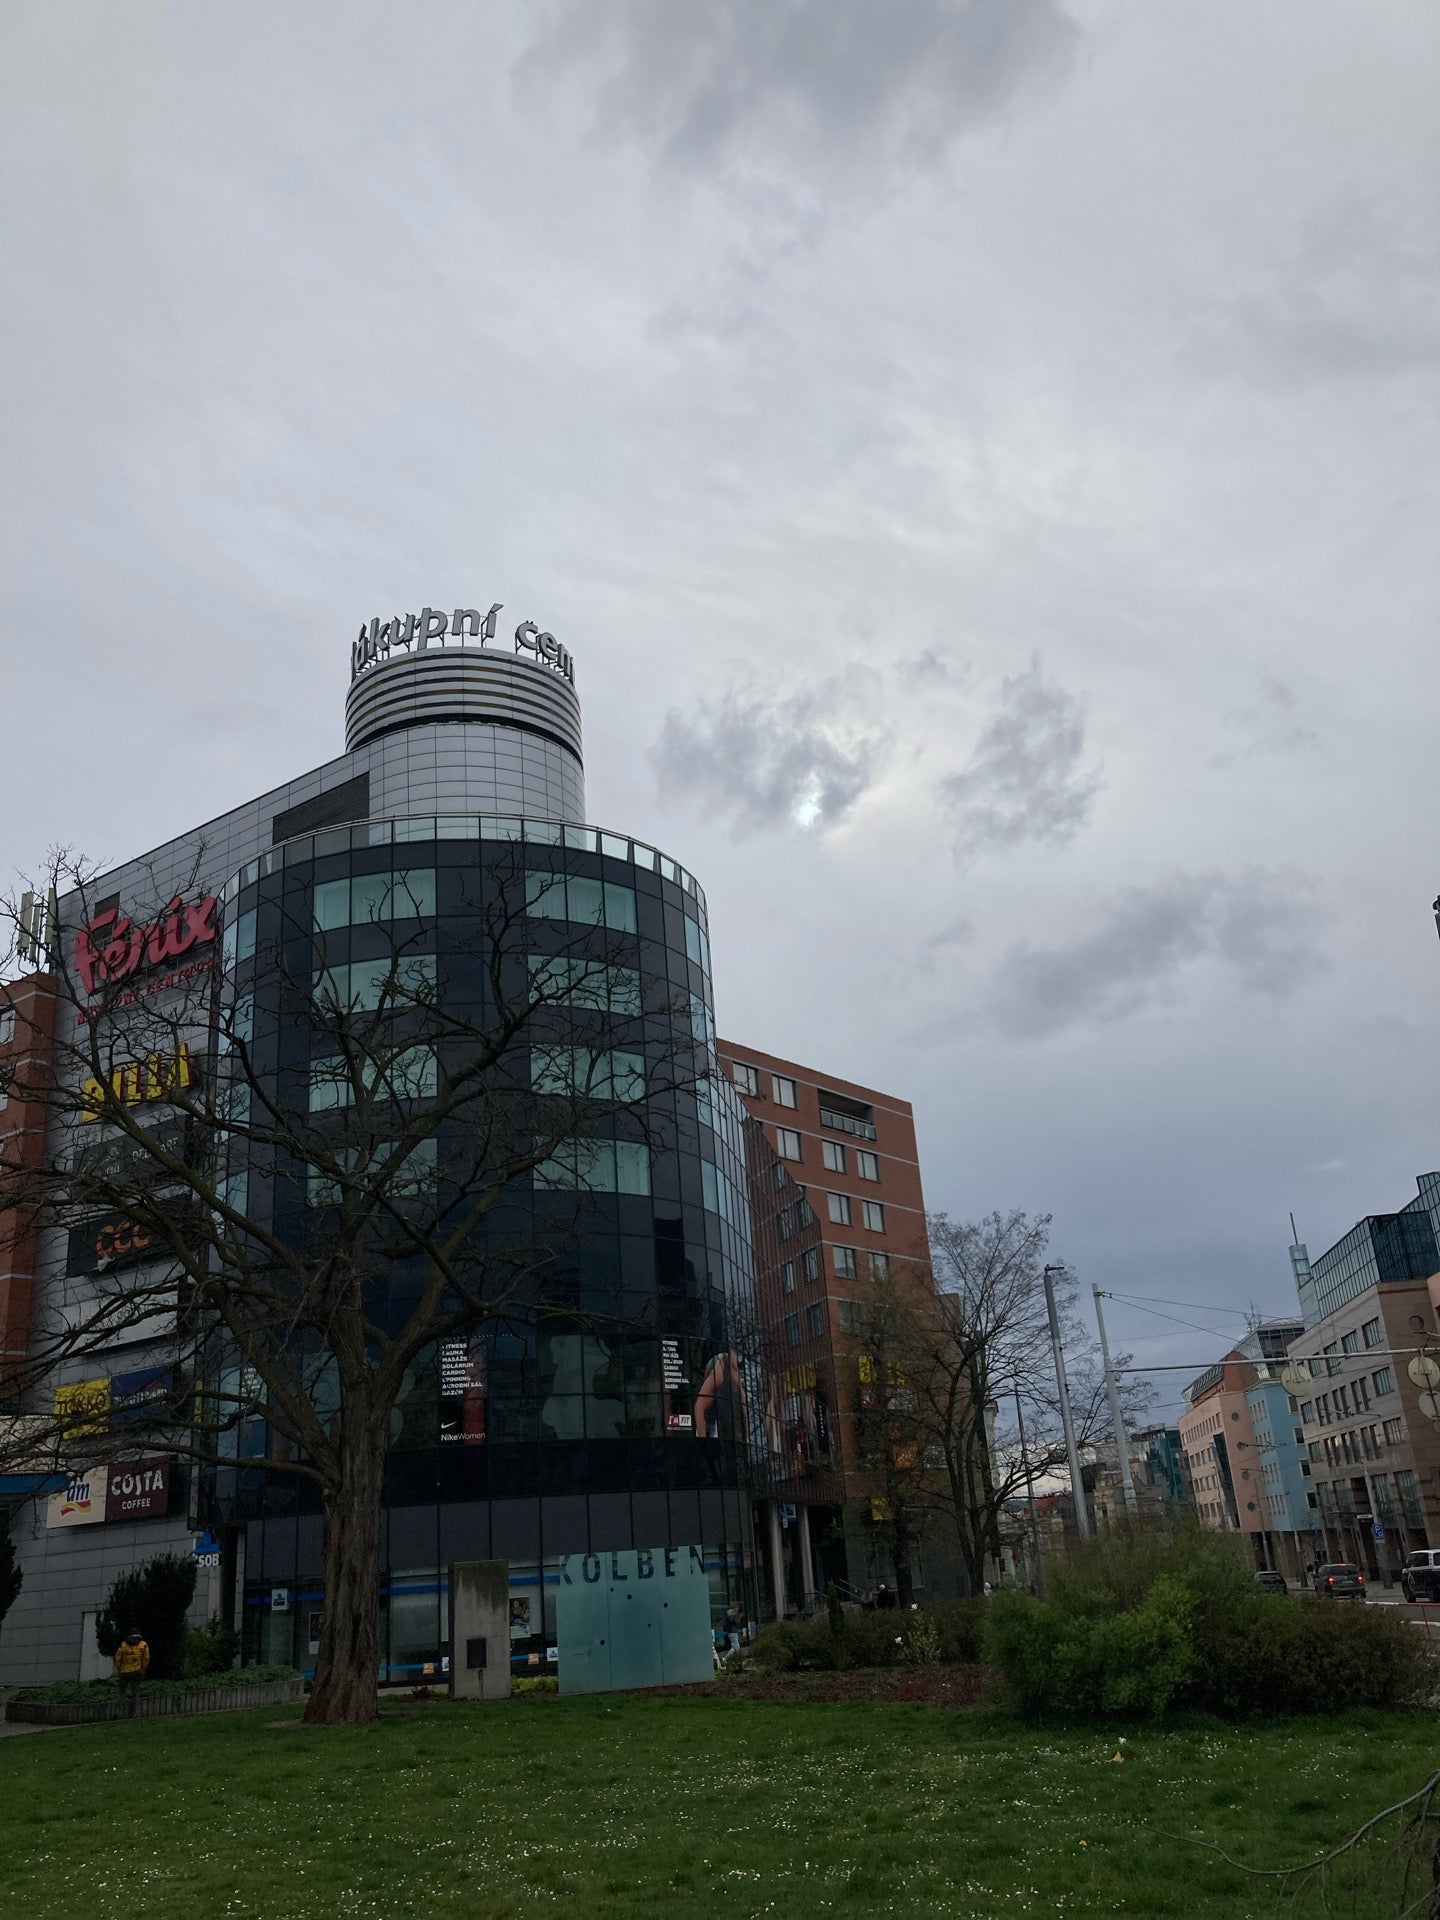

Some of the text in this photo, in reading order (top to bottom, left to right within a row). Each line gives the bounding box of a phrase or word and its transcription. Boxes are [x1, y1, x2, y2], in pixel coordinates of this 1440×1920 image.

[351, 603, 504, 683] ákupní
[75, 896, 217, 994] Fénix
[66, 1469, 164, 1503] dm COSTA
[121, 1497, 151, 1510] COFFEE
